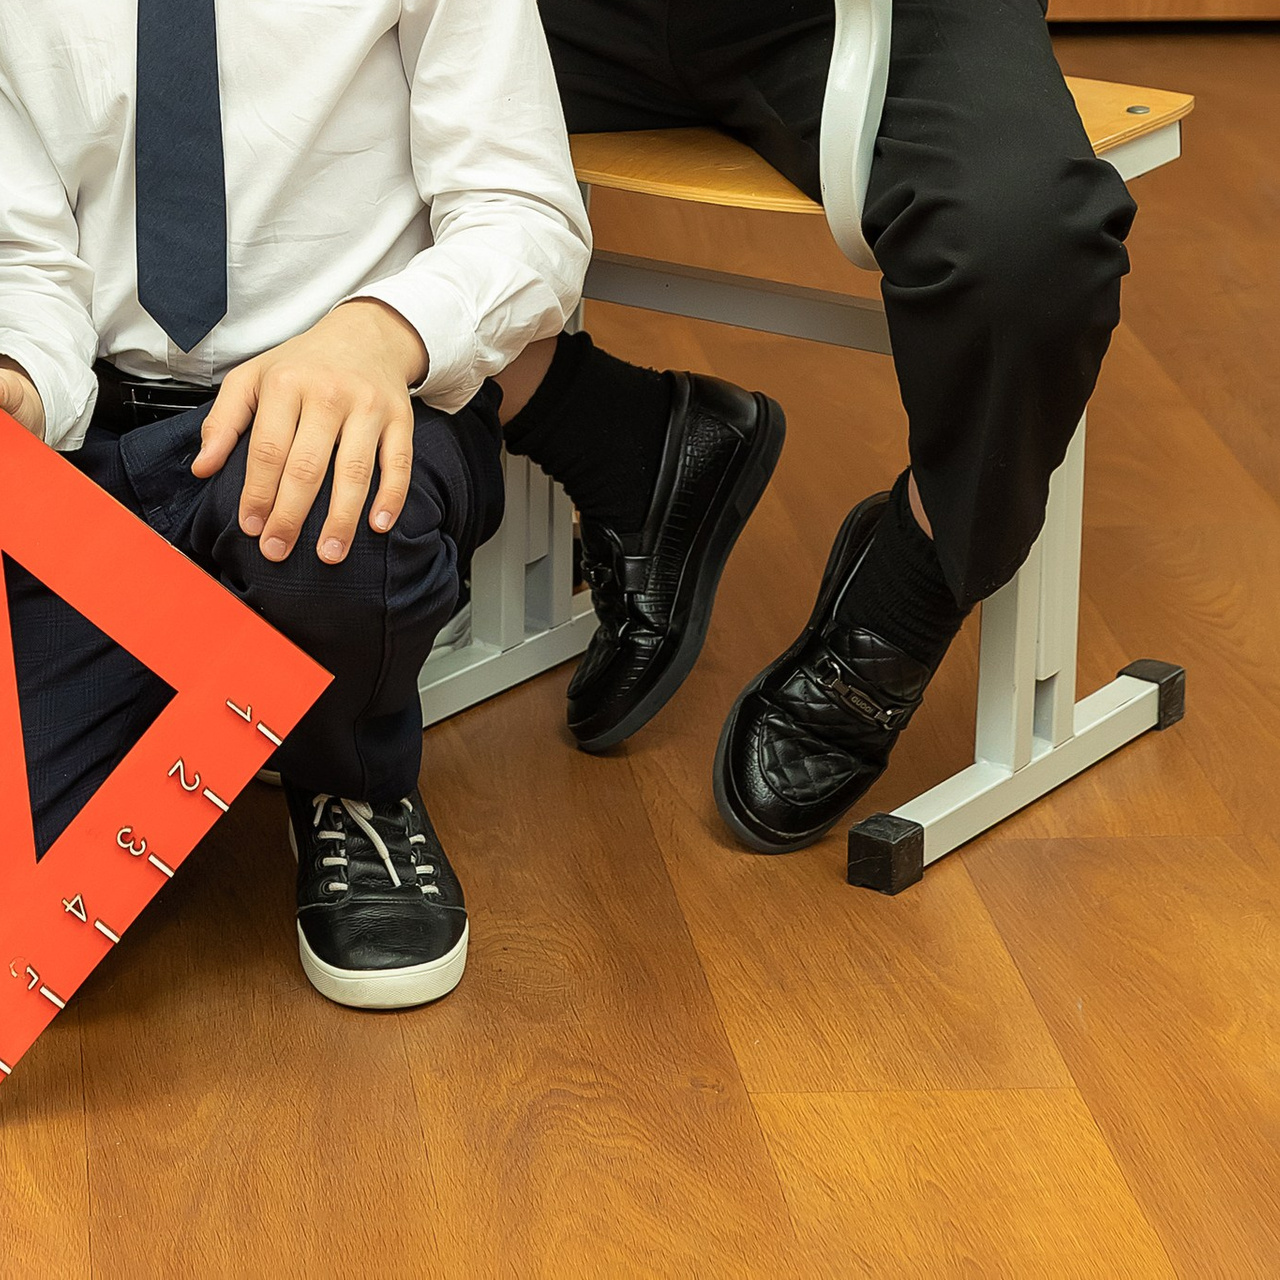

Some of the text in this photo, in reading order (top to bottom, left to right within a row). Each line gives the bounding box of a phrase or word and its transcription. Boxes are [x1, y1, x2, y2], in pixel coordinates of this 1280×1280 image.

[226, 699, 252, 722] 1
[168, 758, 201, 792] 2
[116, 826, 147, 857] 3
[62, 893, 88, 923] 4
